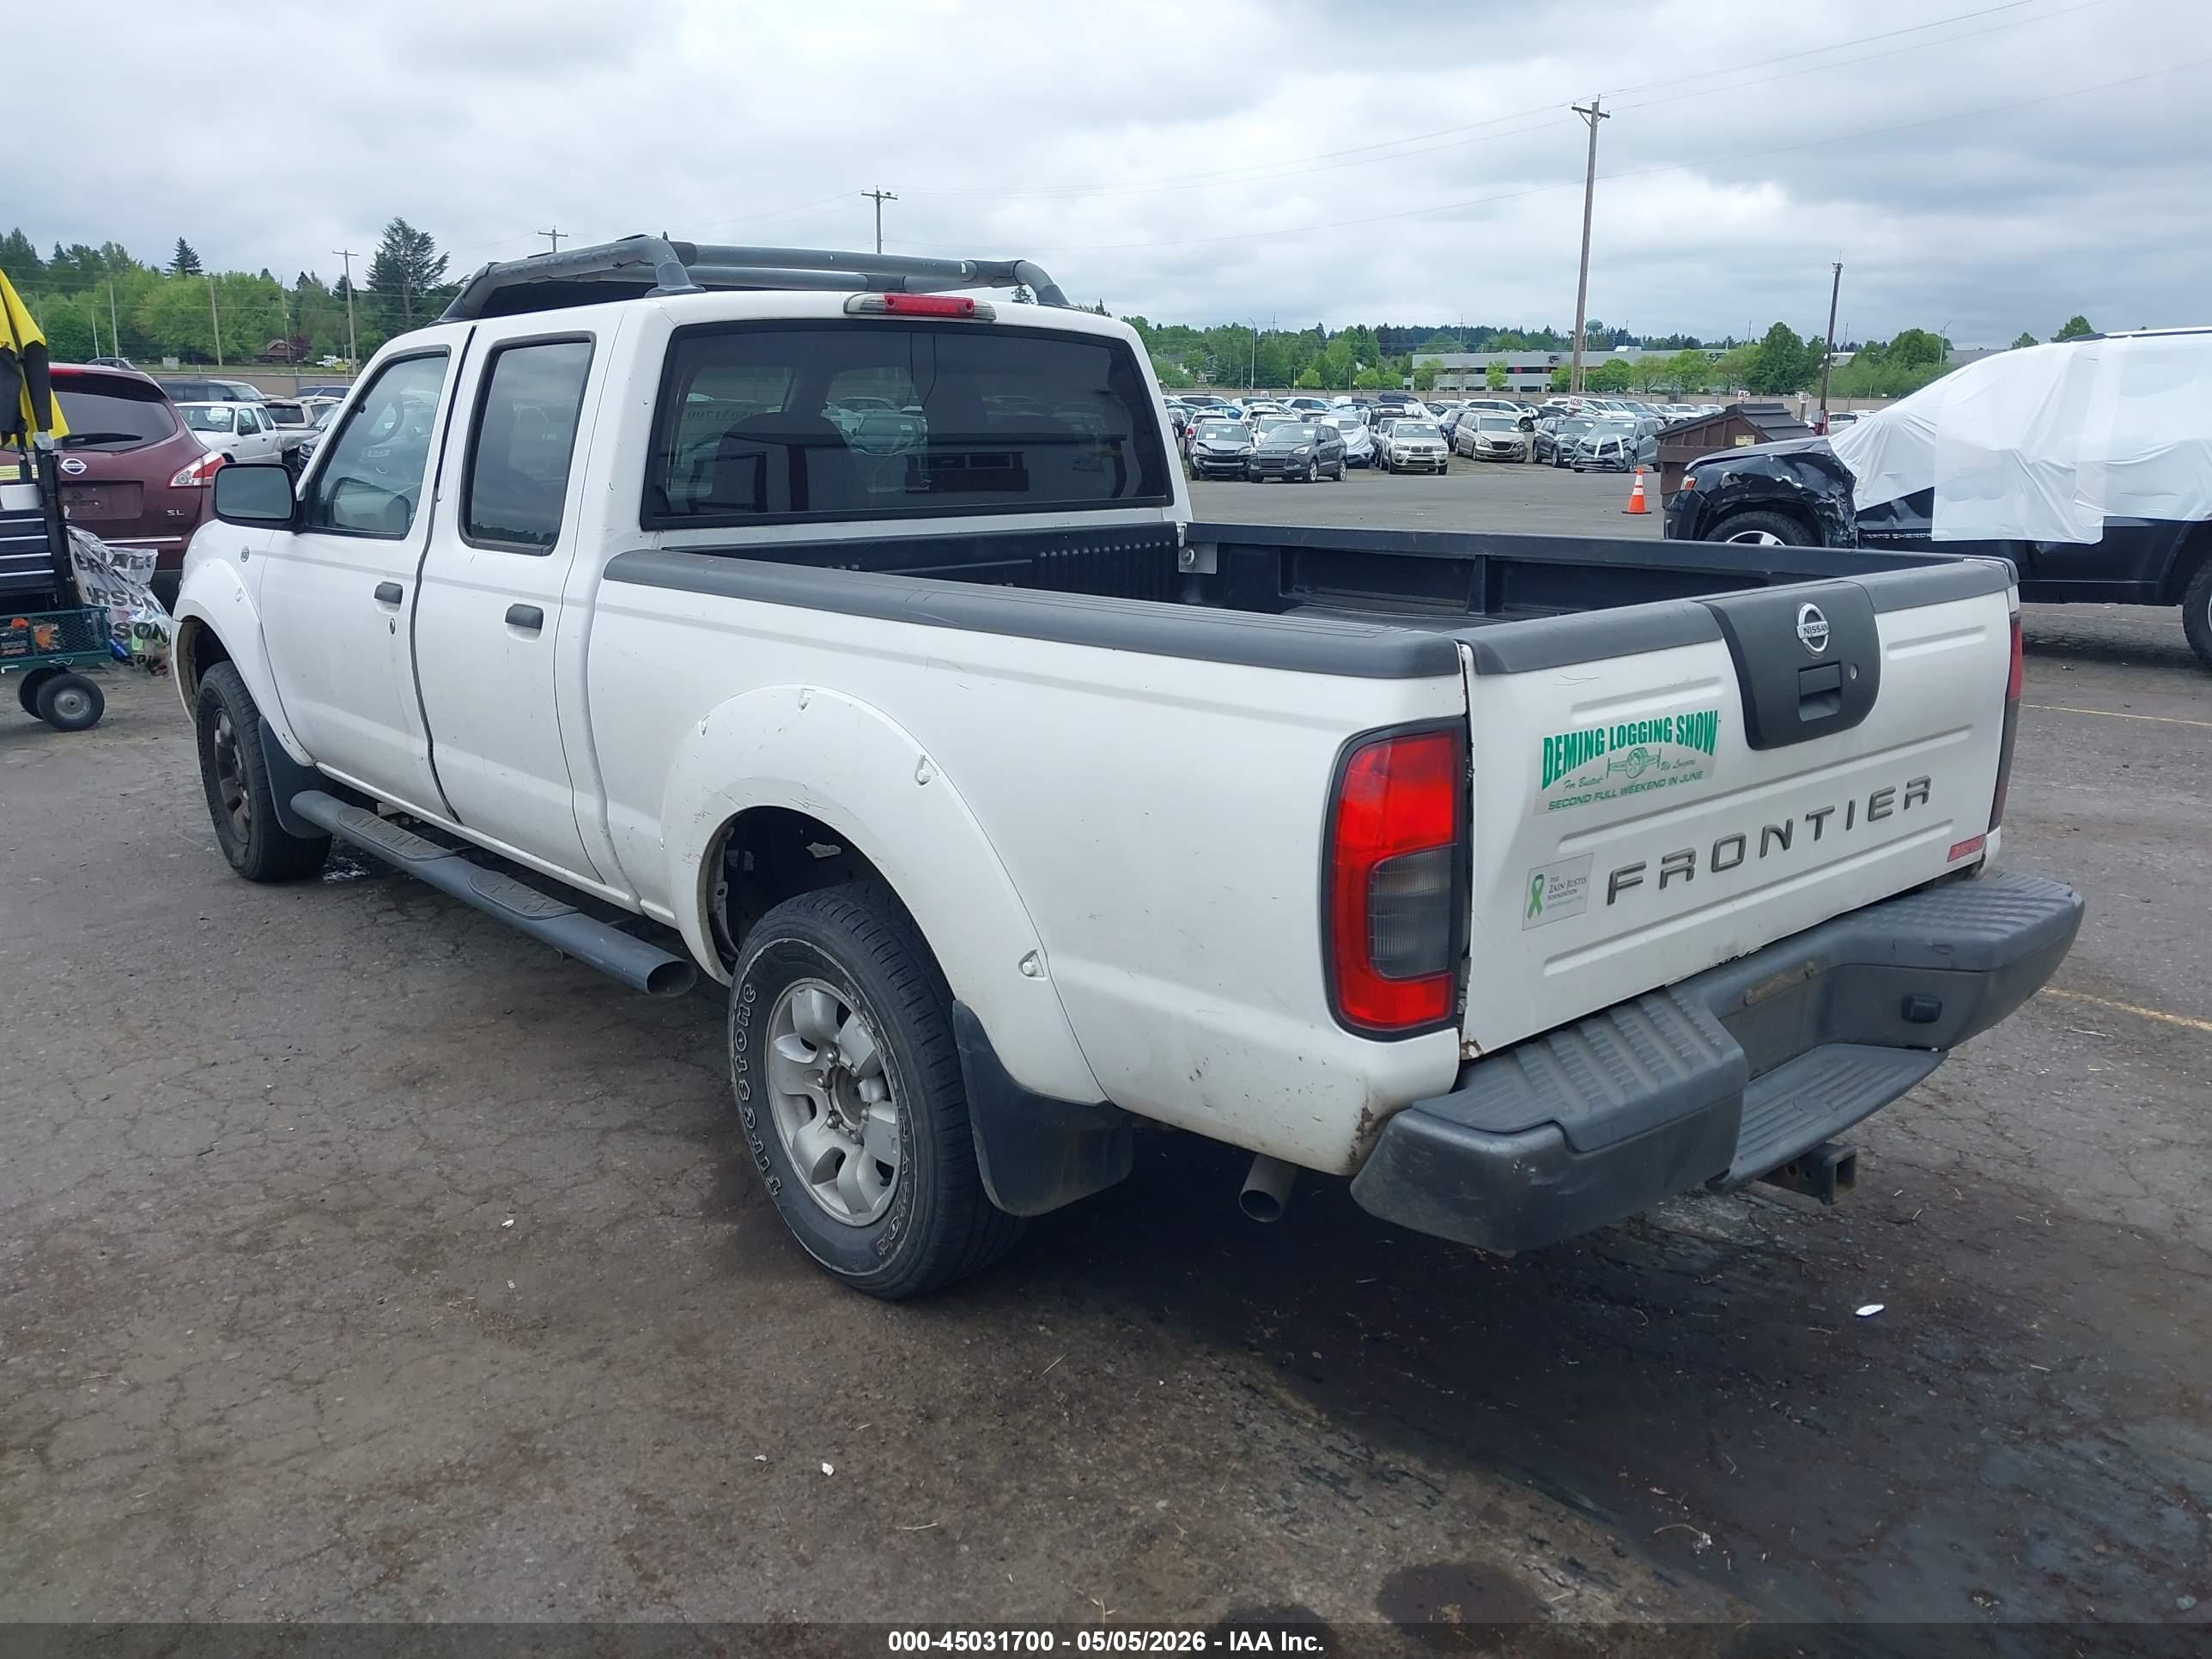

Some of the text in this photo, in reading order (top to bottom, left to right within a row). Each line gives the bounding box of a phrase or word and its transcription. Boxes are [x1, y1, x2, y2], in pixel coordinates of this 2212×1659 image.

[1803, 624, 1827, 635] NISSAN
[1541, 710, 1717, 791] DEMING LOGGING SHOW
[1548, 770, 1704, 811] SECOND FULL WEEKEND IN JUNE
[1563, 779, 1576, 792] For
[1607, 775, 1932, 906] FRONTIER
